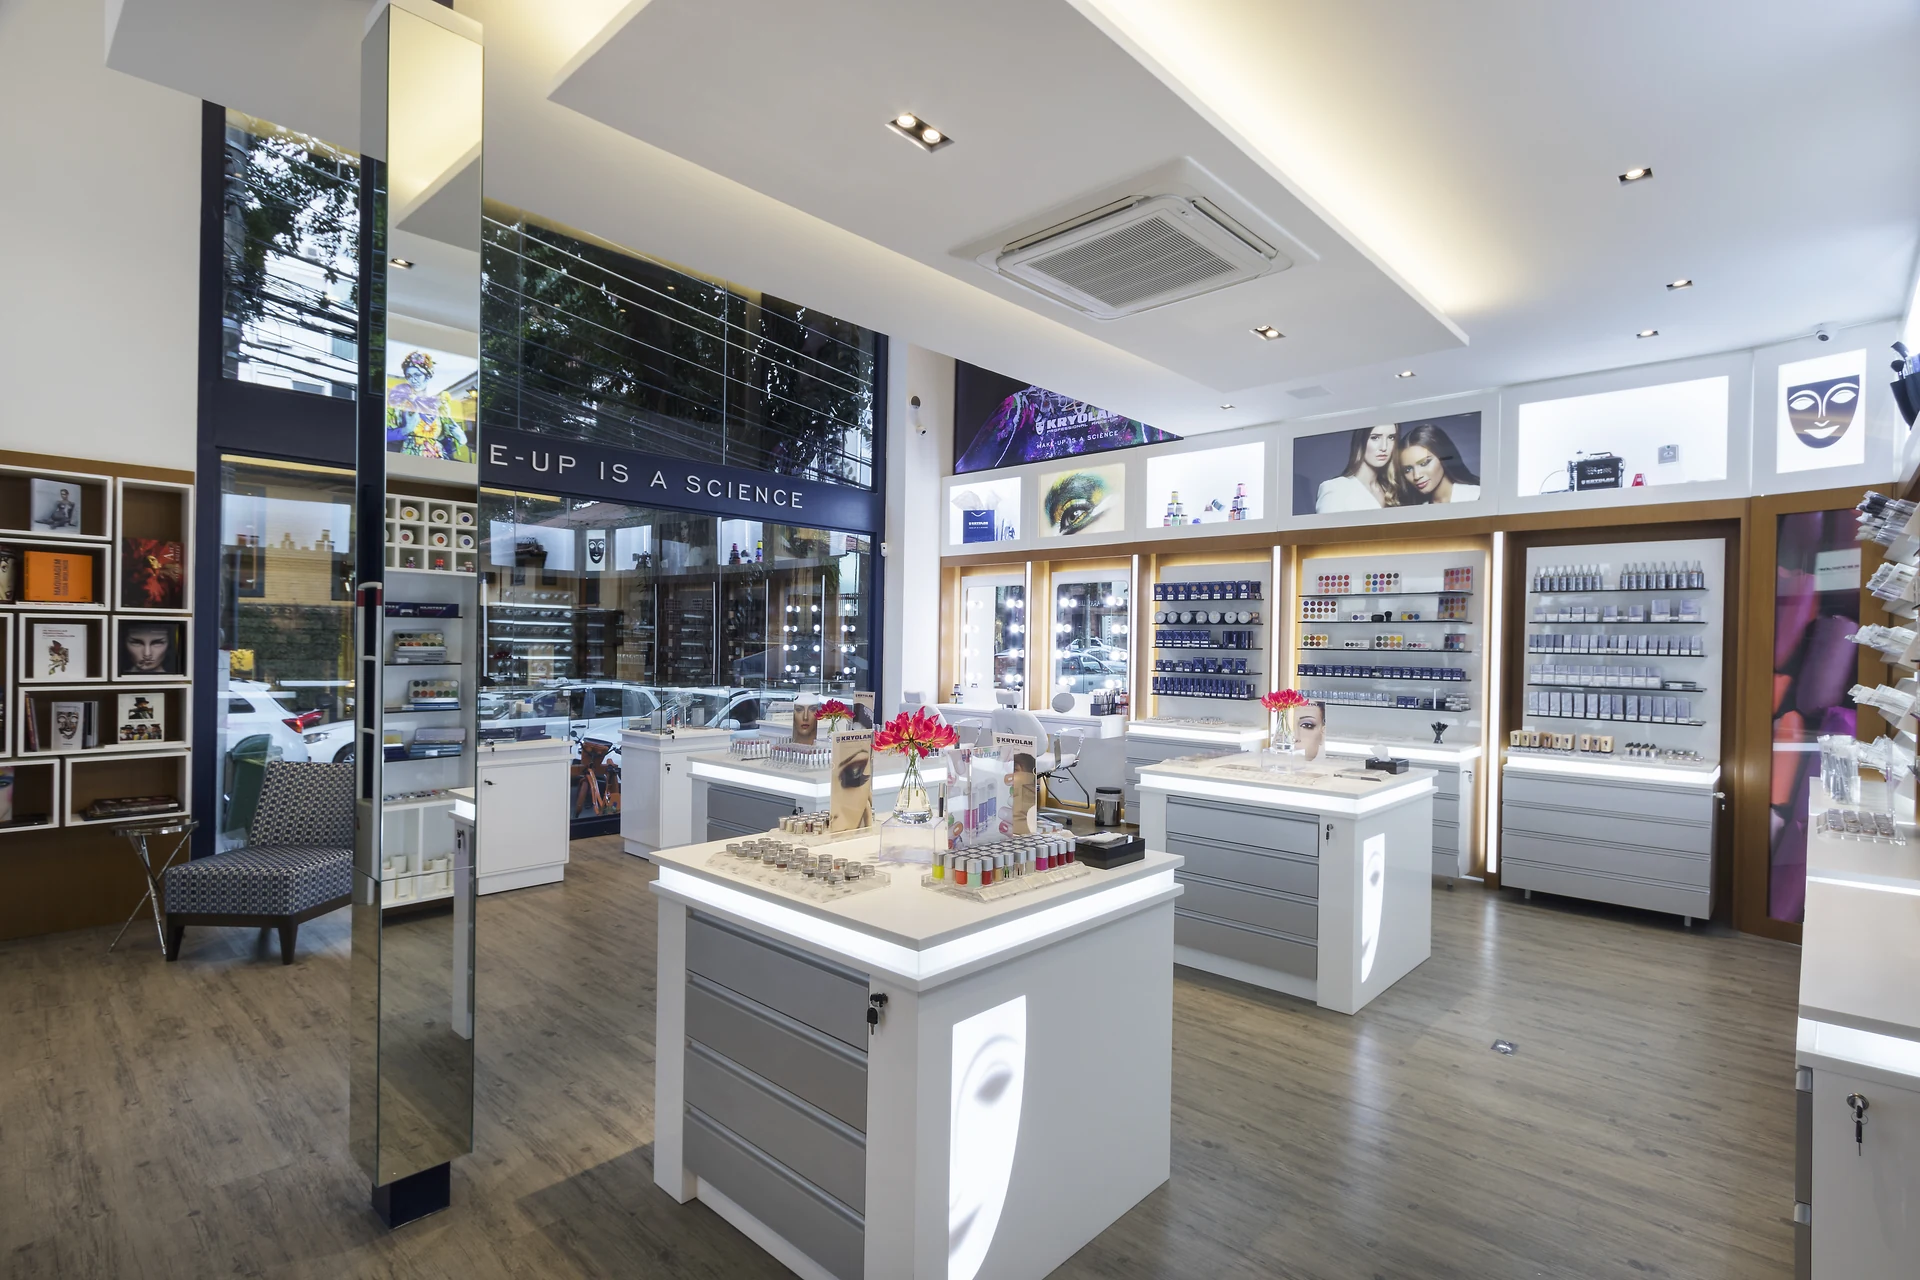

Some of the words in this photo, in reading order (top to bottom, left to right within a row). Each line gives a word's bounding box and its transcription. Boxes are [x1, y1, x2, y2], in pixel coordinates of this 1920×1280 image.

[1036, 440, 1066, 449] MAKE-UP
[1087, 430, 1119, 441] SCIENCE
[489, 443, 577, 474] E-UP
[599, 461, 629, 483] IS
[649, 470, 668, 490] A
[685, 474, 804, 510] SCIENCE
[1001, 737, 1033, 746] KRYOLAN
